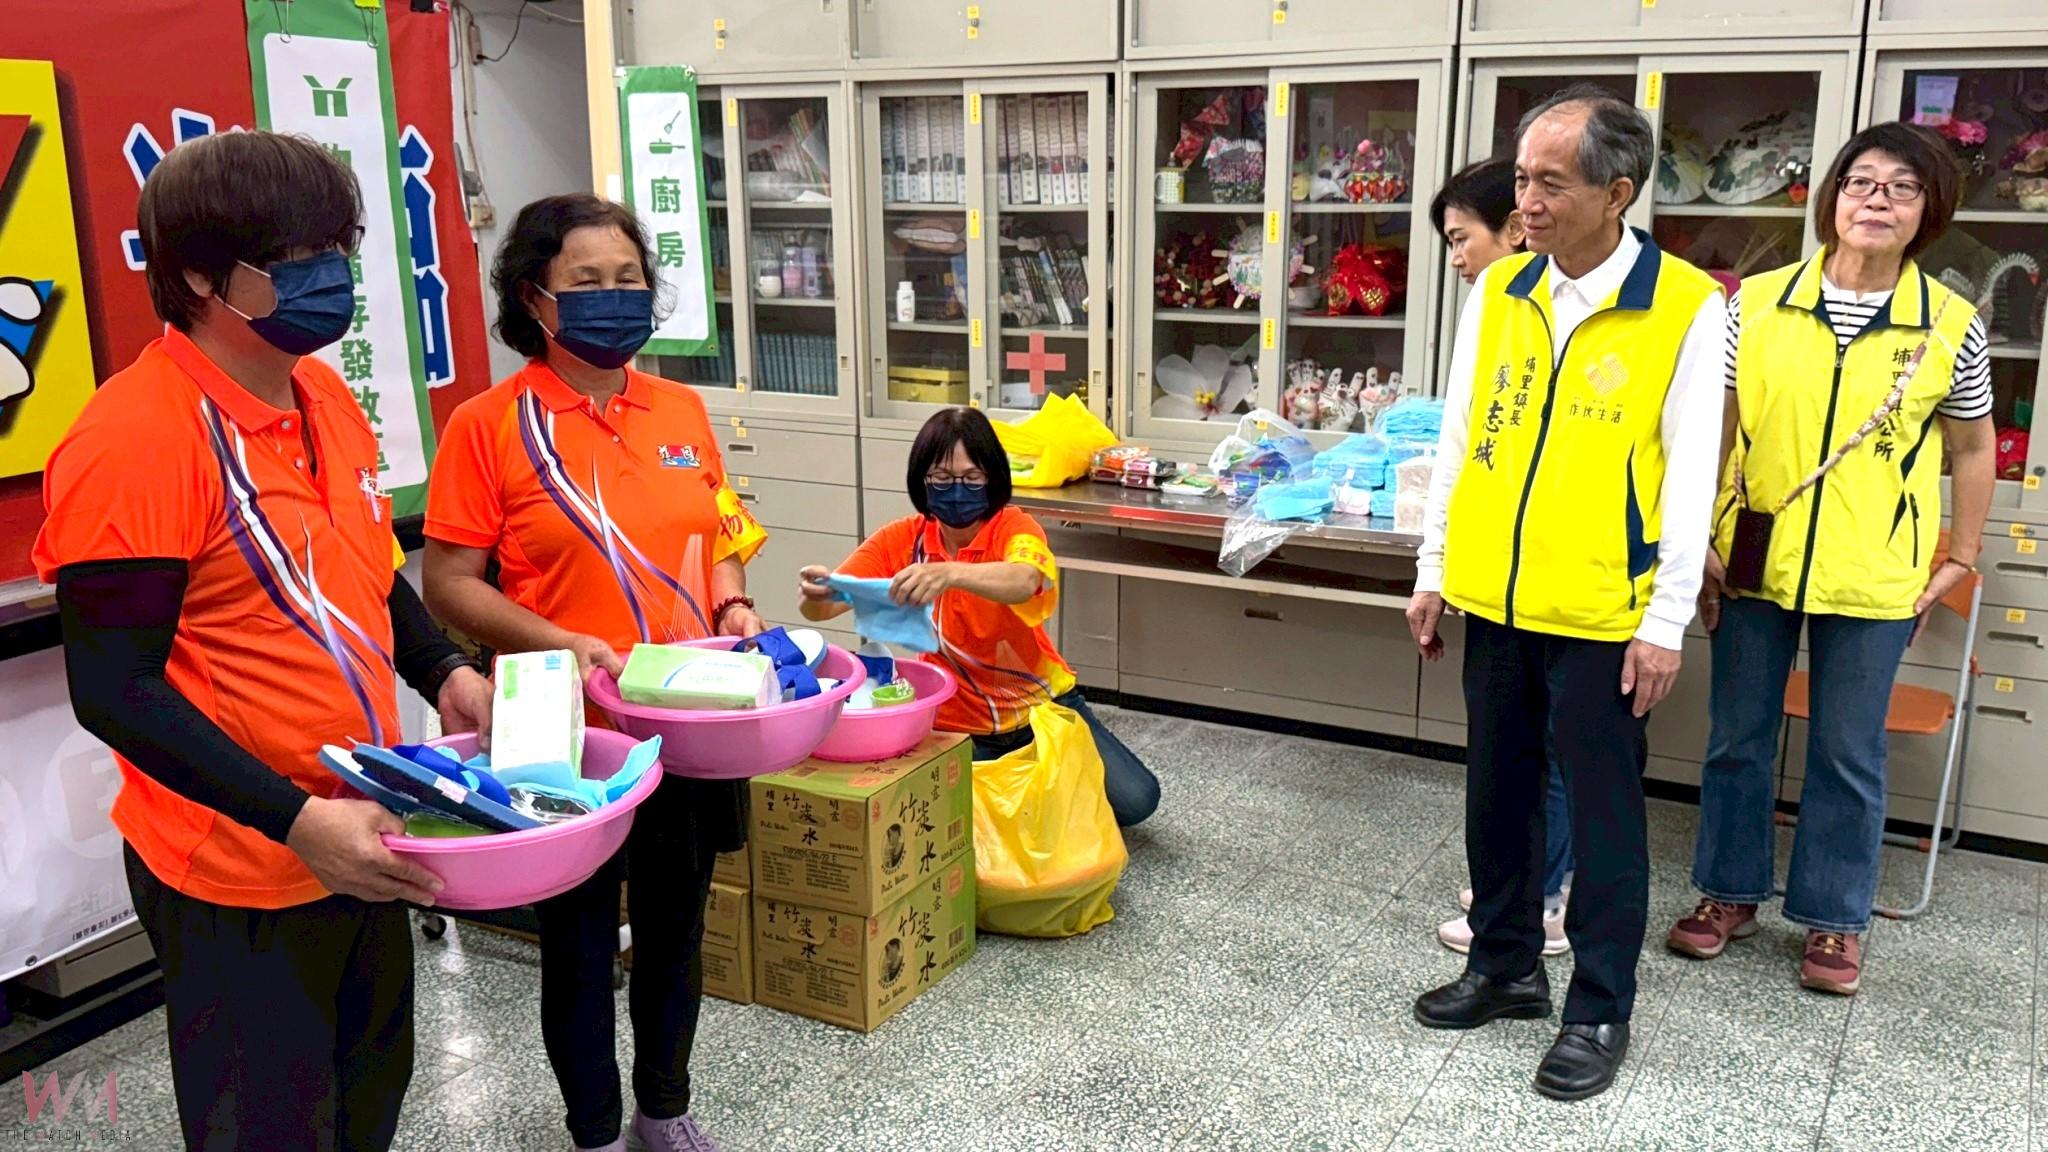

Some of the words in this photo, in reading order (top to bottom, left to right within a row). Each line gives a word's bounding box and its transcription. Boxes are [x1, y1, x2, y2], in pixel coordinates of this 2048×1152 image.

[650, 175, 687, 269] 廚房
[1472, 363, 1511, 471] 廖志城
[1509, 356, 1537, 427] 埔里鎮長
[1569, 403, 1623, 424] 作伙生活
